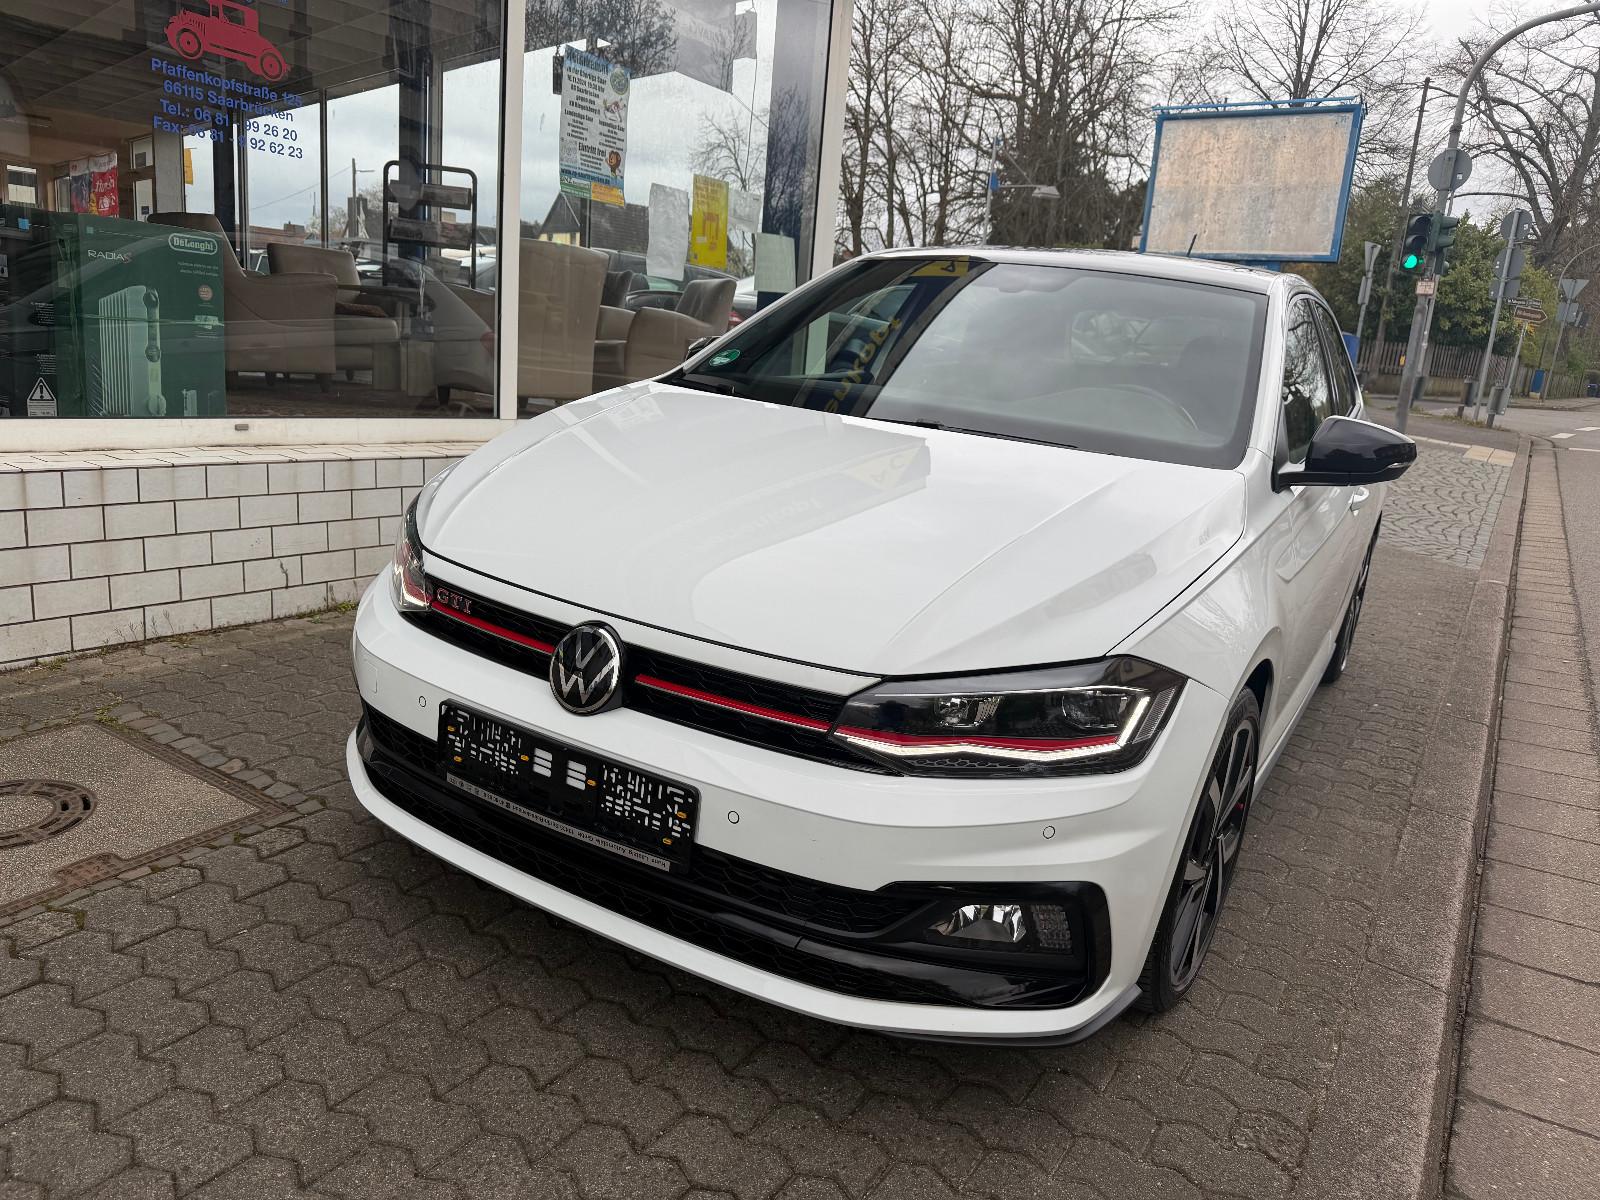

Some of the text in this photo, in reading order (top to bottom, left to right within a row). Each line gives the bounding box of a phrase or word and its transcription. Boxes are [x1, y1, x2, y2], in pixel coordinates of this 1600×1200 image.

[151, 58, 278, 101] Pfaffenkopfstraße
[164, 80, 294, 122] 66115 Saarbrücken
[160, 98, 190, 118] Tel.:
[194, 107, 212, 123] 06
[215, 112, 230, 127] 81
[244, 119, 260, 133] 99
[264, 123, 279, 137] 26
[283, 128, 298, 141] 20
[210, 129, 224, 143] 81
[250, 137, 266, 151] 92
[270, 142, 285, 156] 62
[288, 147, 303, 159] 23
[88, 249, 132, 264] RADIAS
[436, 587, 472, 615] GTI
